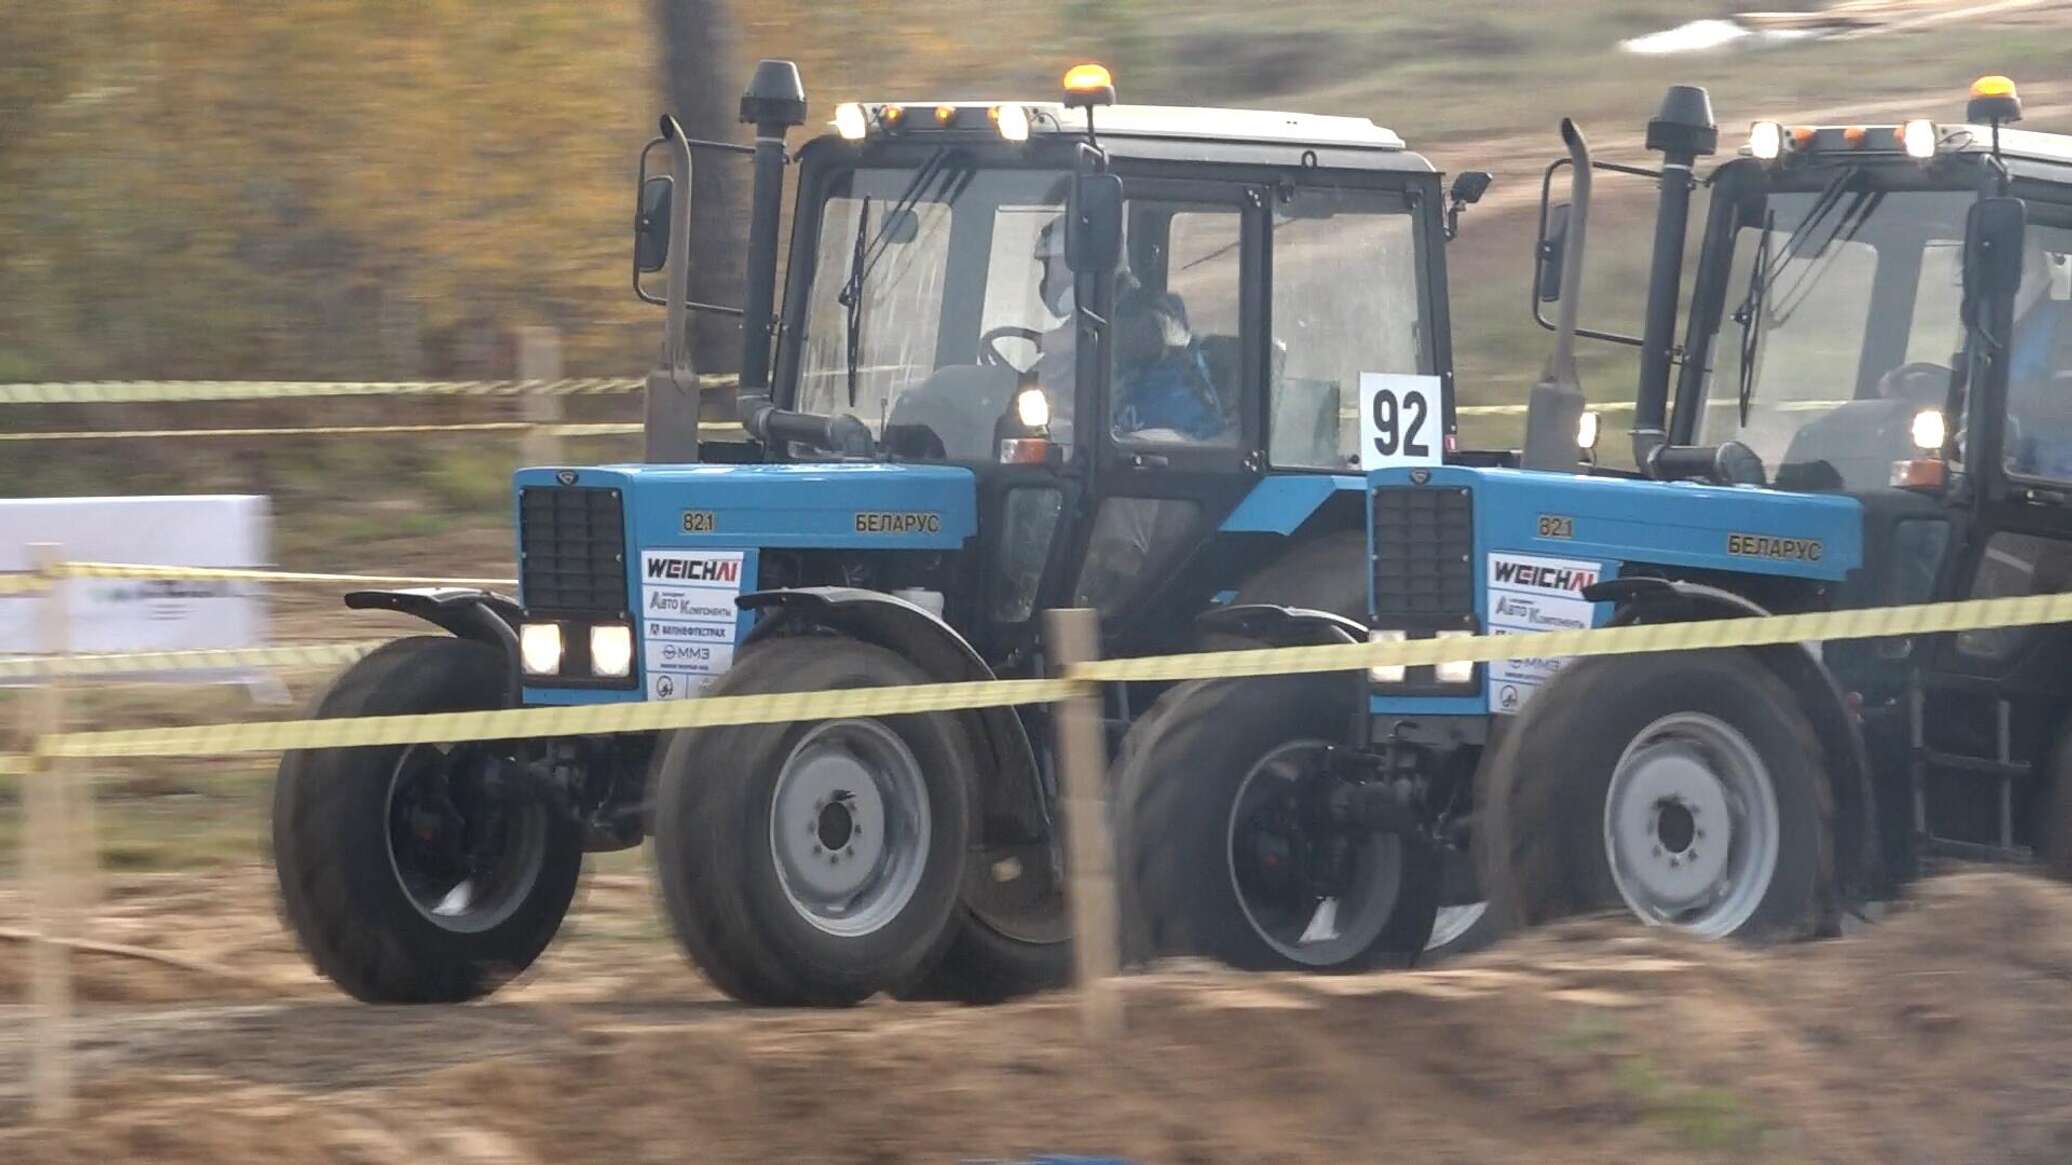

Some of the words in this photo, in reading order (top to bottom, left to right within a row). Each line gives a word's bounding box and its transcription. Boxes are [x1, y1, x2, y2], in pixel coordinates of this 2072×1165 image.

[1373, 389, 1429, 457] 92
[856, 514, 939, 532] БЕЛАРУС
[1728, 535, 1822, 561] БЕЛАРУС
[647, 558, 738, 582] WEICHAI
